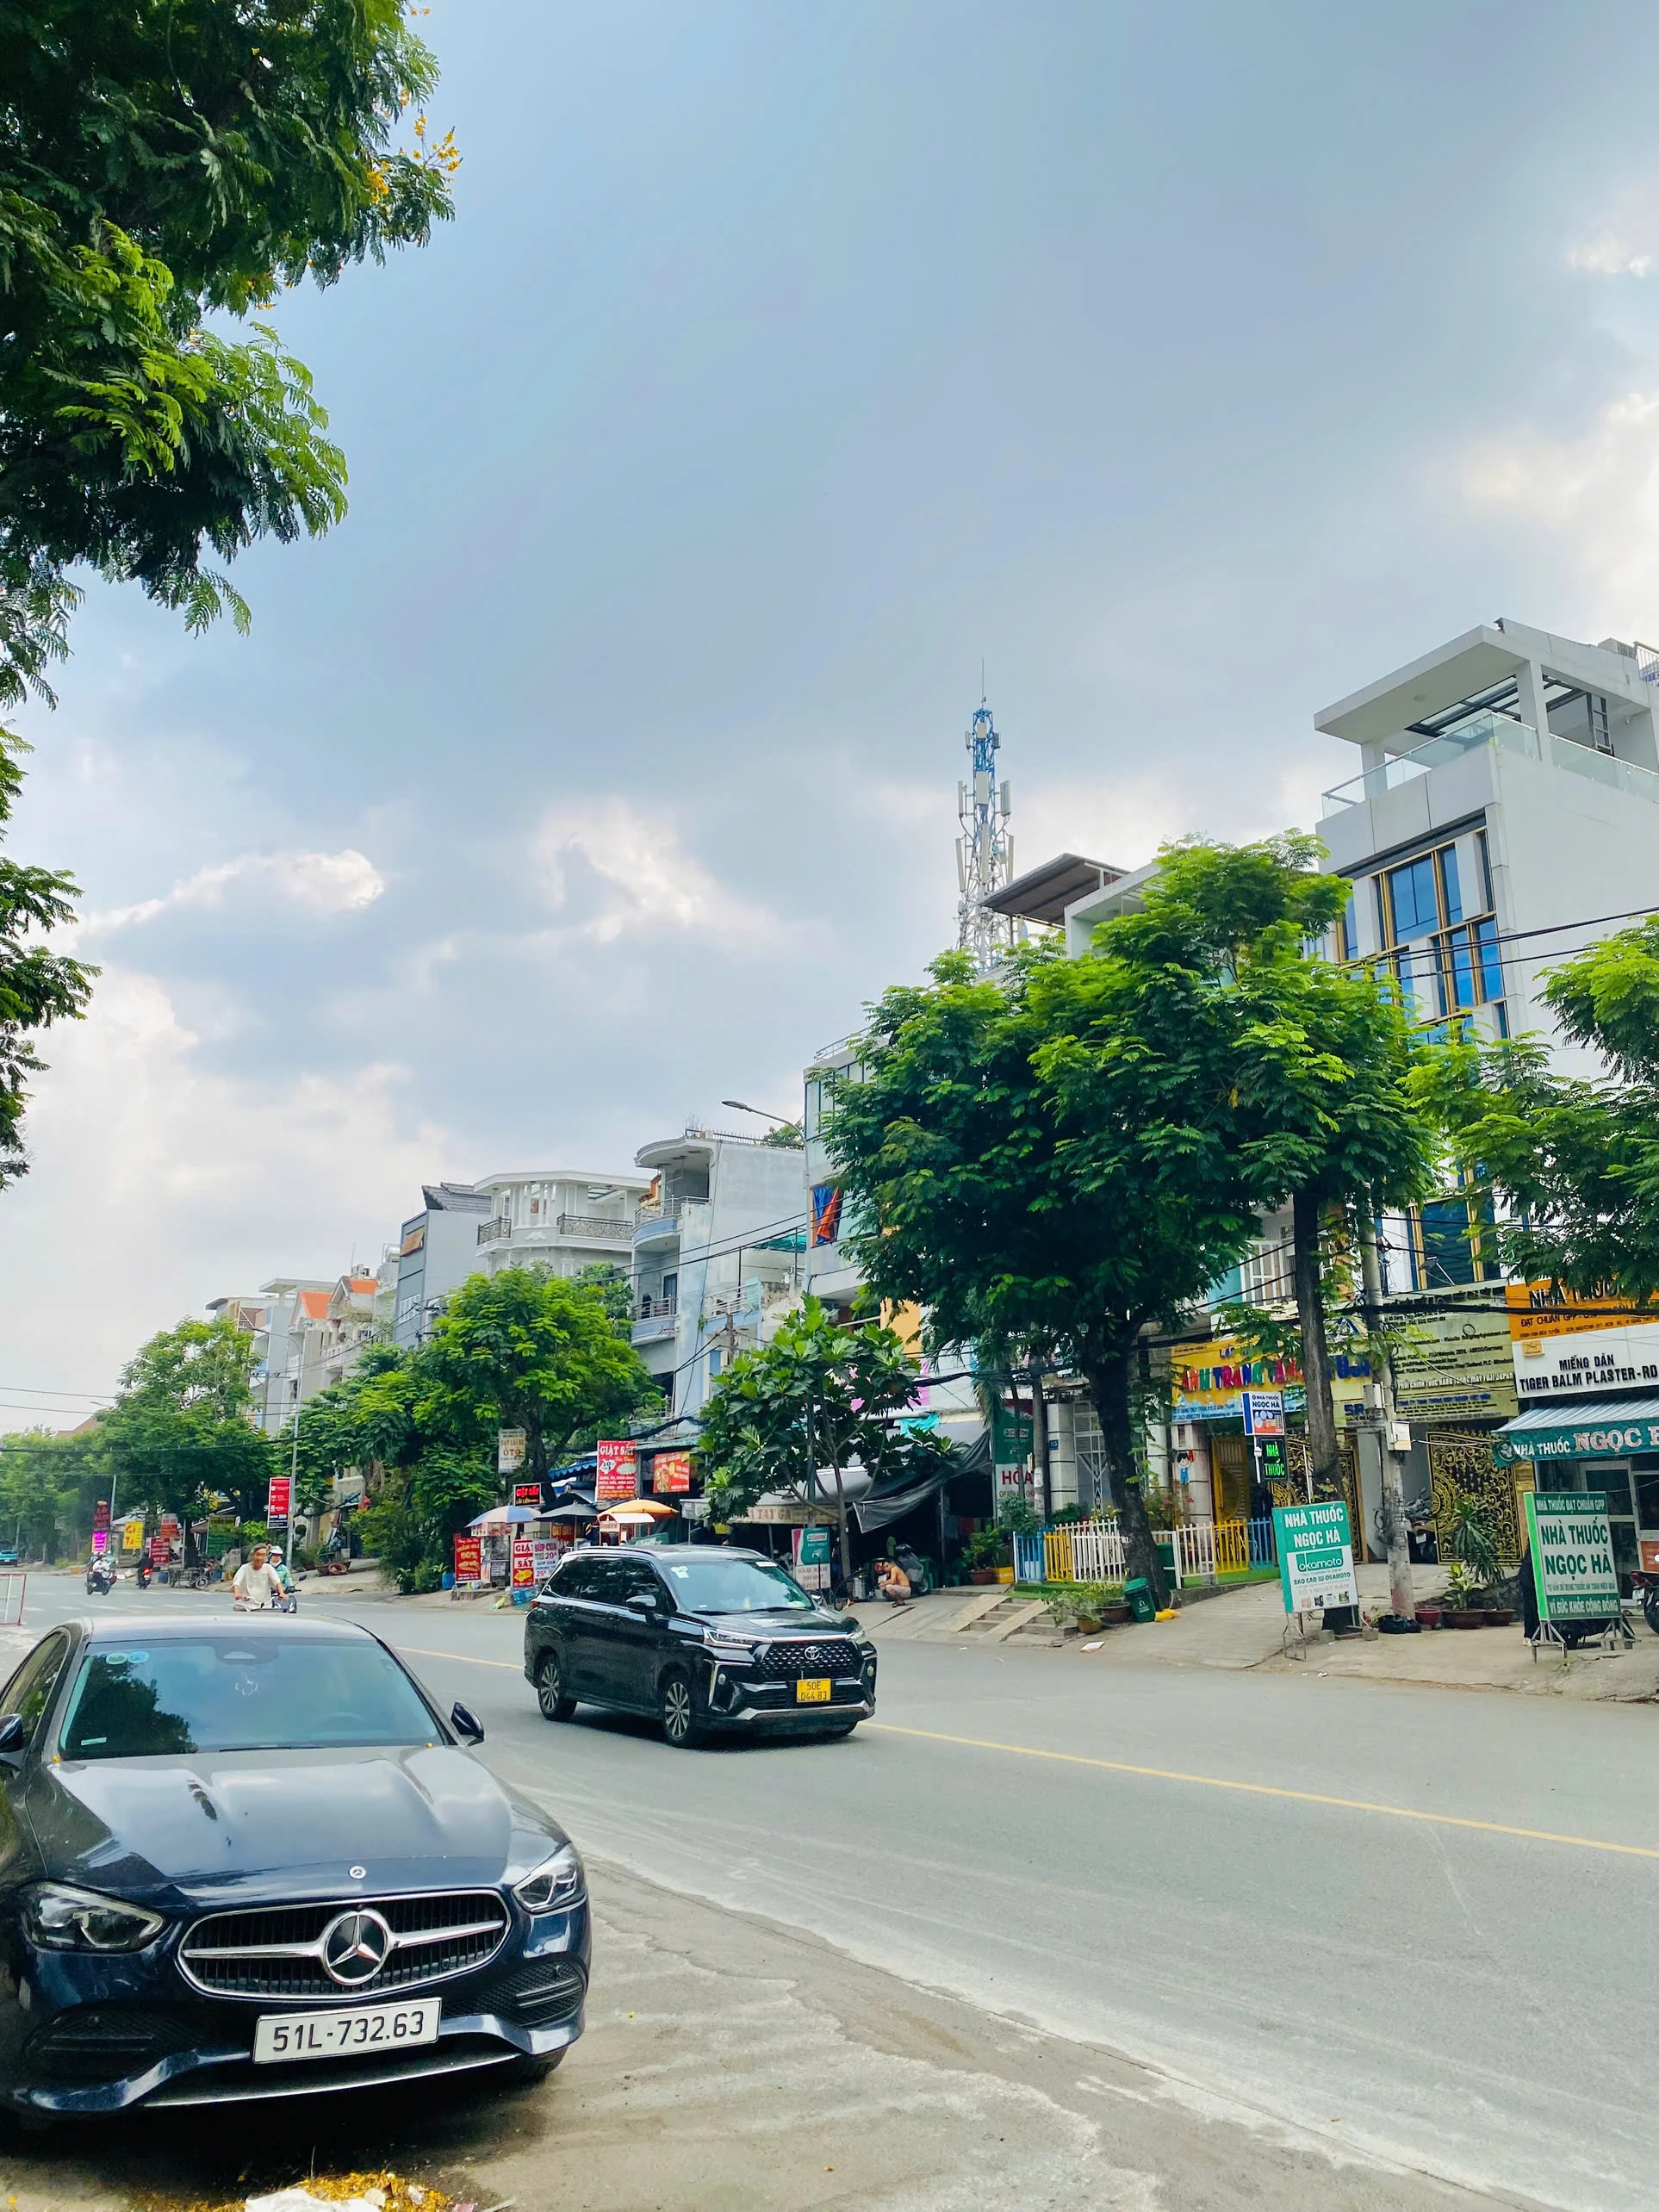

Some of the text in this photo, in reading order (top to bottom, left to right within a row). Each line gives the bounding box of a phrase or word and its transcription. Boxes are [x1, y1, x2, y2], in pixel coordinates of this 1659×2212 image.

[1594, 1352, 1615, 1368] DÁN
[1519, 1376, 1550, 1392] TIGER
[1551, 1372, 1583, 1388] BALM
[1513, 1440, 1535, 1456] NHÀ
[1537, 1436, 1571, 1455] THUỐC
[1573, 1427, 1643, 1453] NGỌC
[1284, 1503, 1344, 1528] NHÀ THUỐC
[1294, 1526, 1341, 1549] NGỌC HÀ
[1541, 1516, 1608, 1545] NHÀ THUỐC
[1544, 1548, 1612, 1581] NGỌC HÀ
[273, 2010, 424, 2052] 51L-732.63
